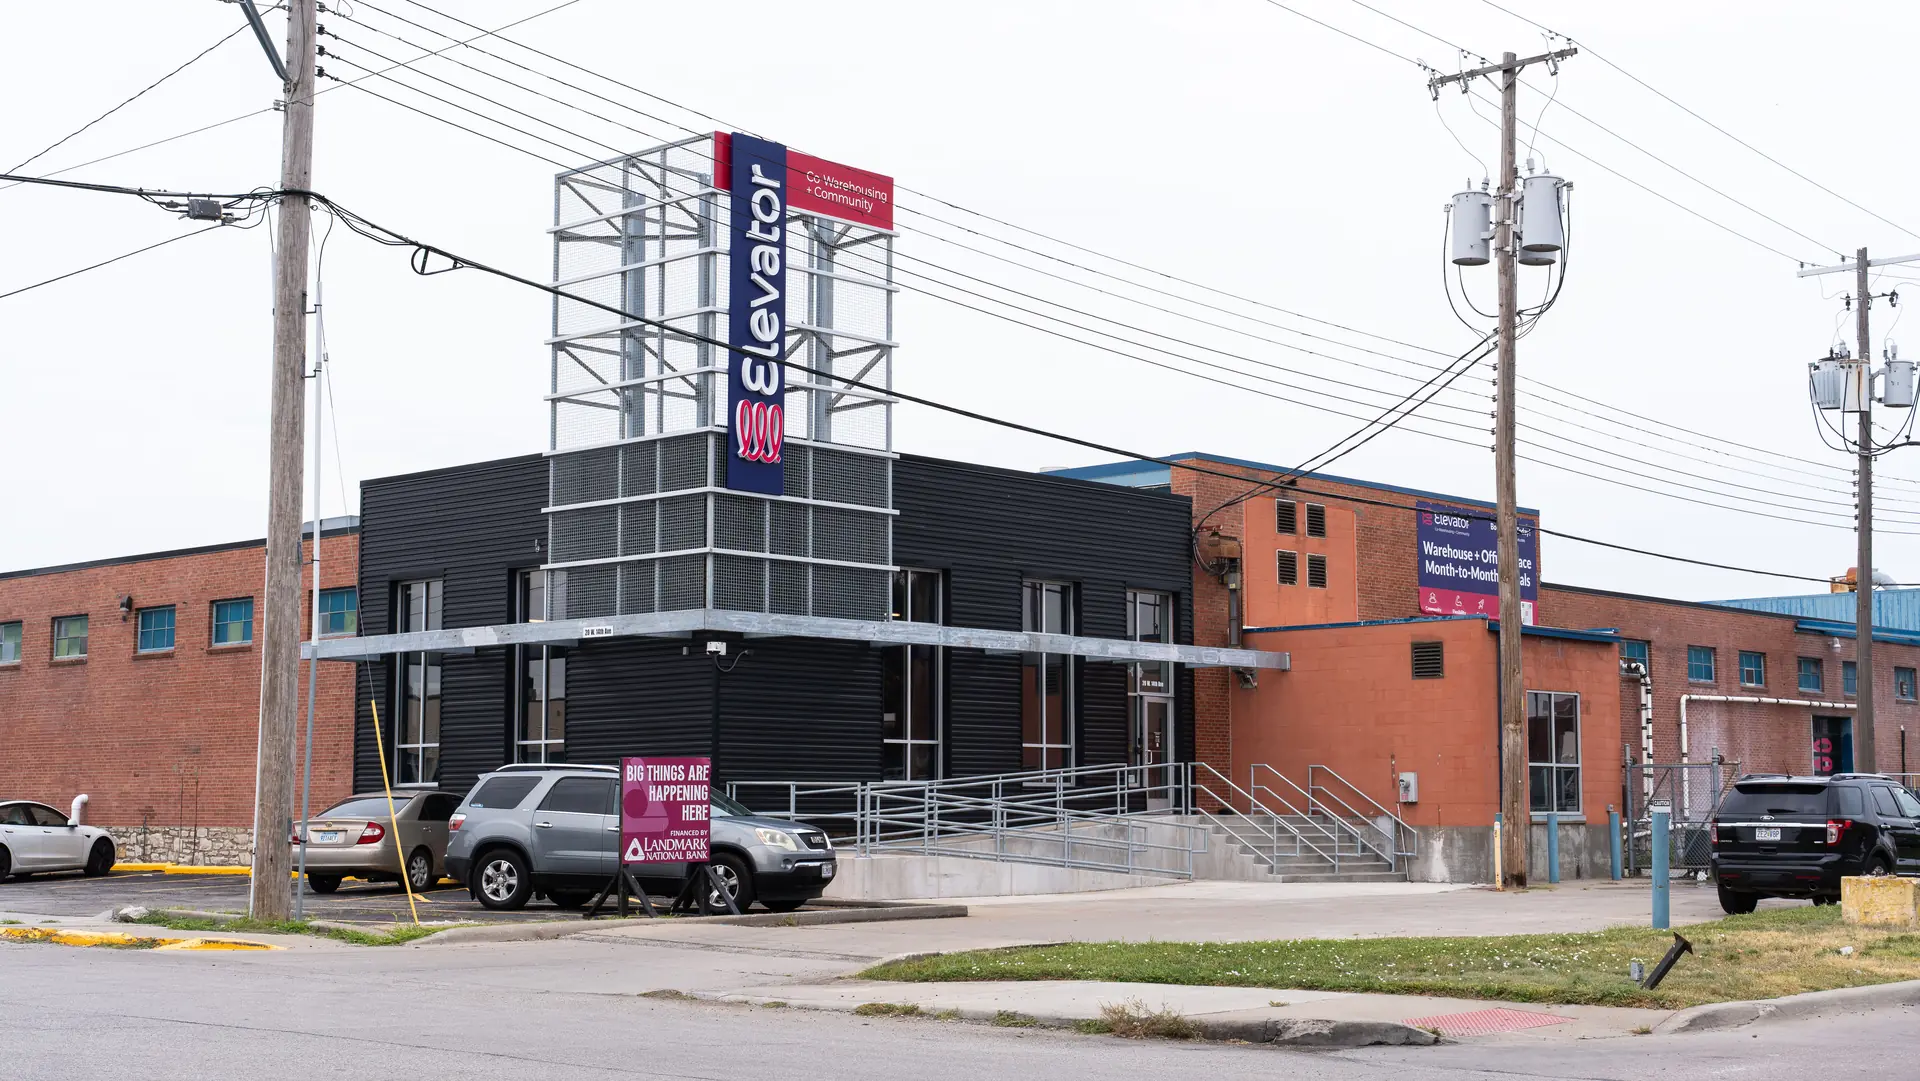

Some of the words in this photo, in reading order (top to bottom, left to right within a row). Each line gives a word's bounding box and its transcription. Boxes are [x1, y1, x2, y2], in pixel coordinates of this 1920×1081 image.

[806, 186, 812, 194] +
[814, 186, 874, 213] Community
[742, 164, 782, 396] Elevator
[1434, 513, 1469, 529] Elevator
[1423, 541, 1473, 561] Warehouse
[1474, 551, 1480, 560] +
[1481, 549, 1498, 565] Offi
[1518, 558, 1532, 570] ace
[1425, 560, 1499, 583] Month-to-Month
[626, 765, 644, 781] BIG
[647, 765, 685, 781] THINGS
[688, 764, 710, 781] ARE
[649, 785, 708, 801] HAPPENING
[682, 804, 708, 821] HERE
[644, 837, 708, 851] LANDMARK
[646, 851, 684, 860] NATIONAL
[686, 850, 708, 859] BANK
